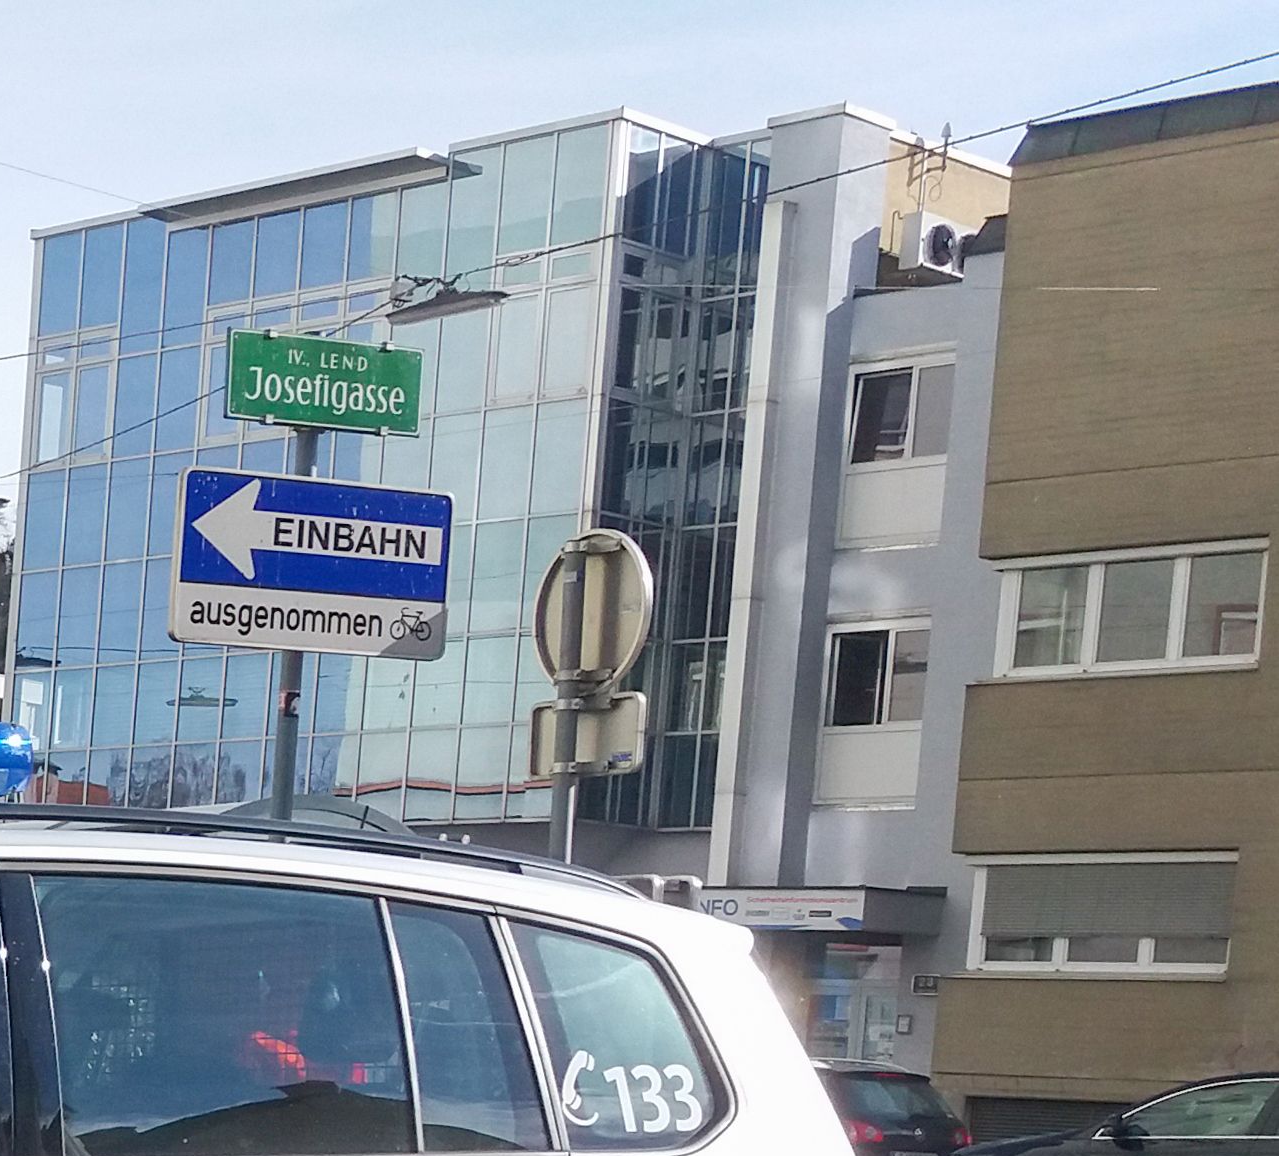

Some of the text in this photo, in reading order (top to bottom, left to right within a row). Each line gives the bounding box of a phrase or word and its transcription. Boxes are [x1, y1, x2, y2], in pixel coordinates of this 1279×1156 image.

[320, 351, 369, 373] LEND
[244, 366, 405, 416] Josefigasse
[273, 517, 427, 560] EINBAHN
[190, 600, 383, 638] ausgenommen
[603, 1064, 703, 1133] 133
